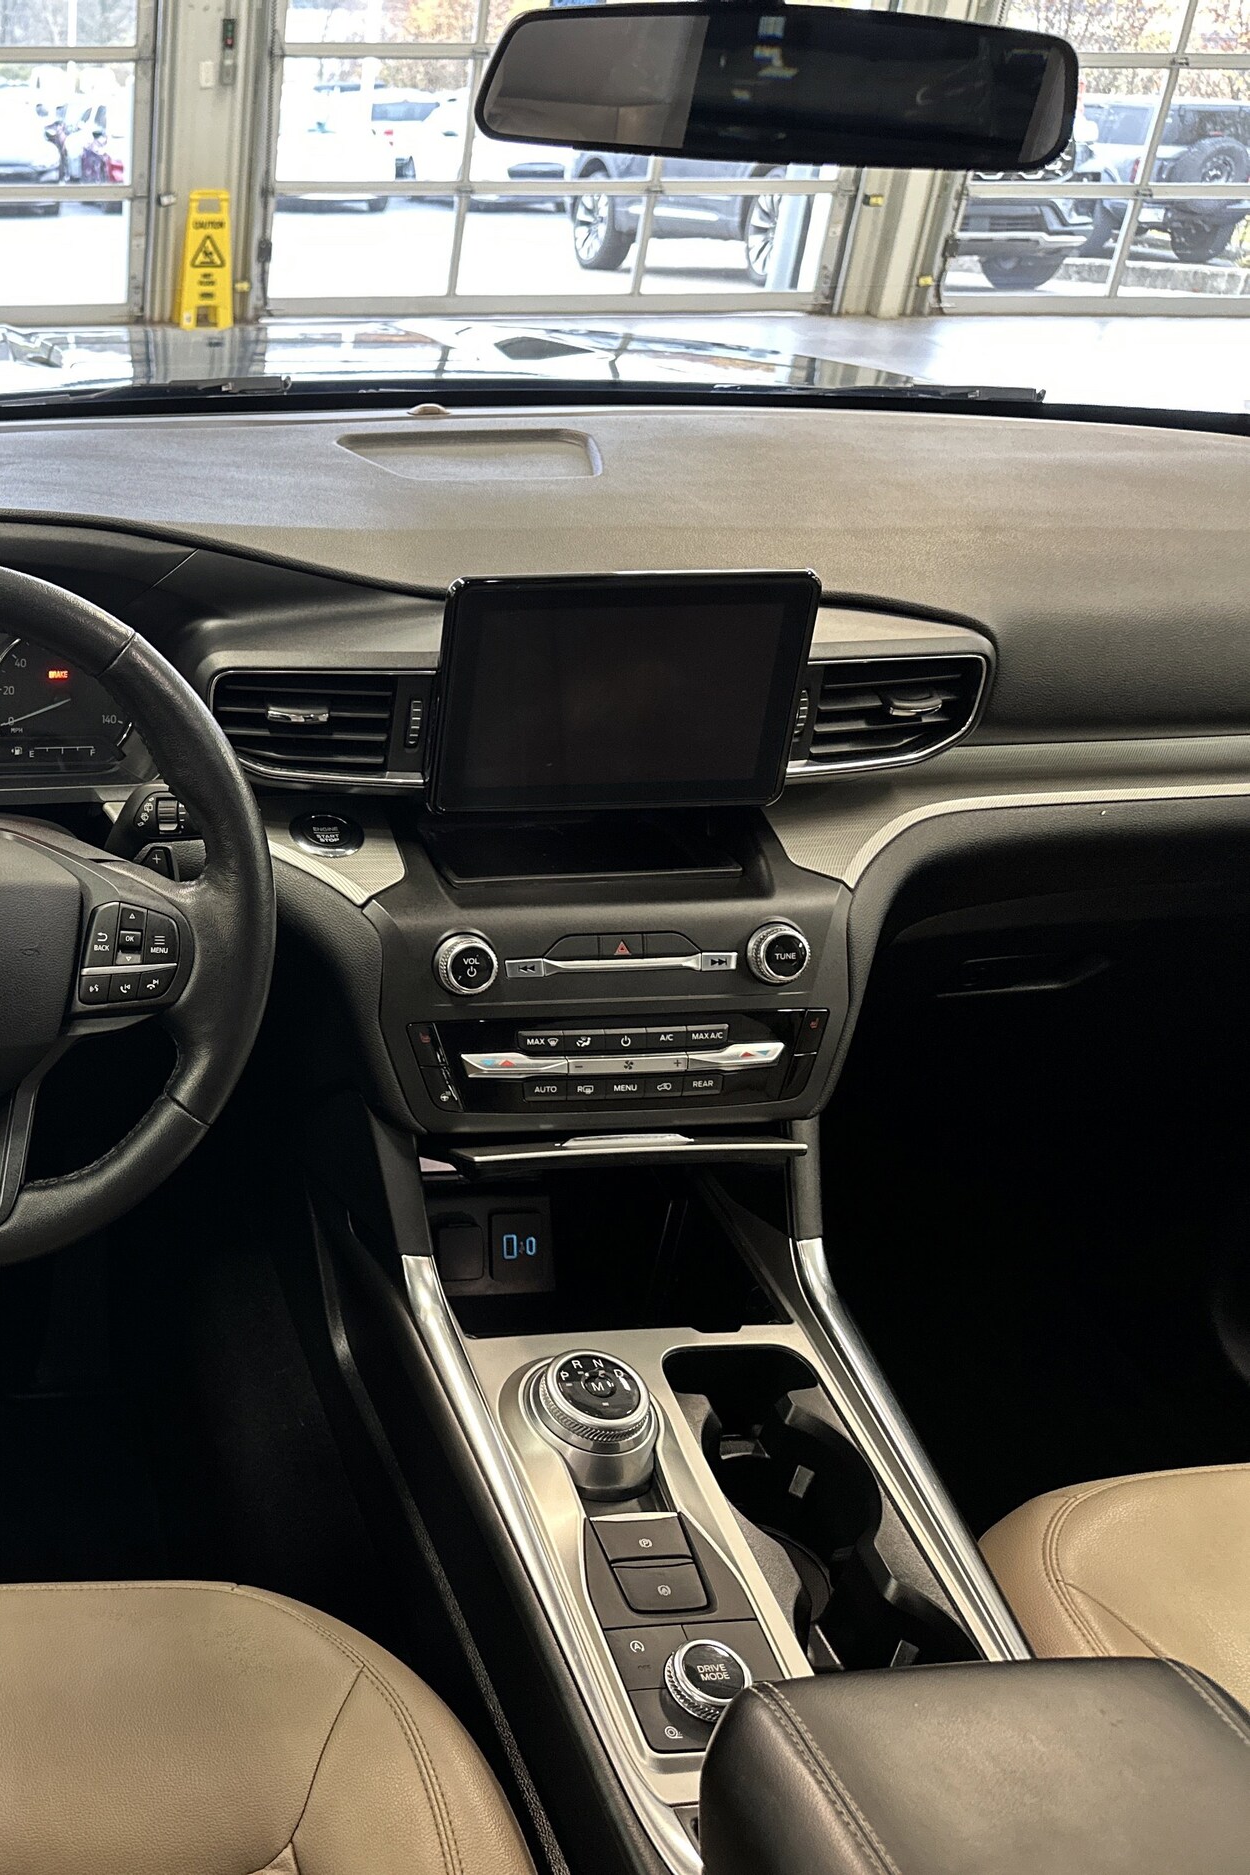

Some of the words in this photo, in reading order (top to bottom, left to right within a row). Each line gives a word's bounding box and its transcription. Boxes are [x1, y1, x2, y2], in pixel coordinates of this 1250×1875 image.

[14, 658, 27, 668] 40
[48, 670, 68, 679] BRAKE
[3, 685, 15, 696] 20
[101, 714, 117, 725] 140
[28, 750, 35, 758] E
[93, 944, 110, 952] BACK
[150, 946, 169, 954] MENU
[774, 952, 797, 960] TUNE
[462, 957, 481, 965] VOL
[659, 1034, 674, 1042] A/C
[691, 1032, 709, 1040] MAX
[709, 1031, 724, 1039] A/C
[526, 1038, 546, 1046] MAX
[613, 1084, 638, 1092] MENU
[692, 1080, 714, 1088] REAR
[534, 1085, 557, 1093] AUTO
[571, 1360, 583, 1369] R
[592, 1358, 604, 1368] N
[560, 1371, 570, 1381] P
[613, 1369, 624, 1379] D
[591, 1382, 605, 1392] M
[696, 1663, 727, 1673] DRIVE
[700, 1671, 731, 1681] MODE
